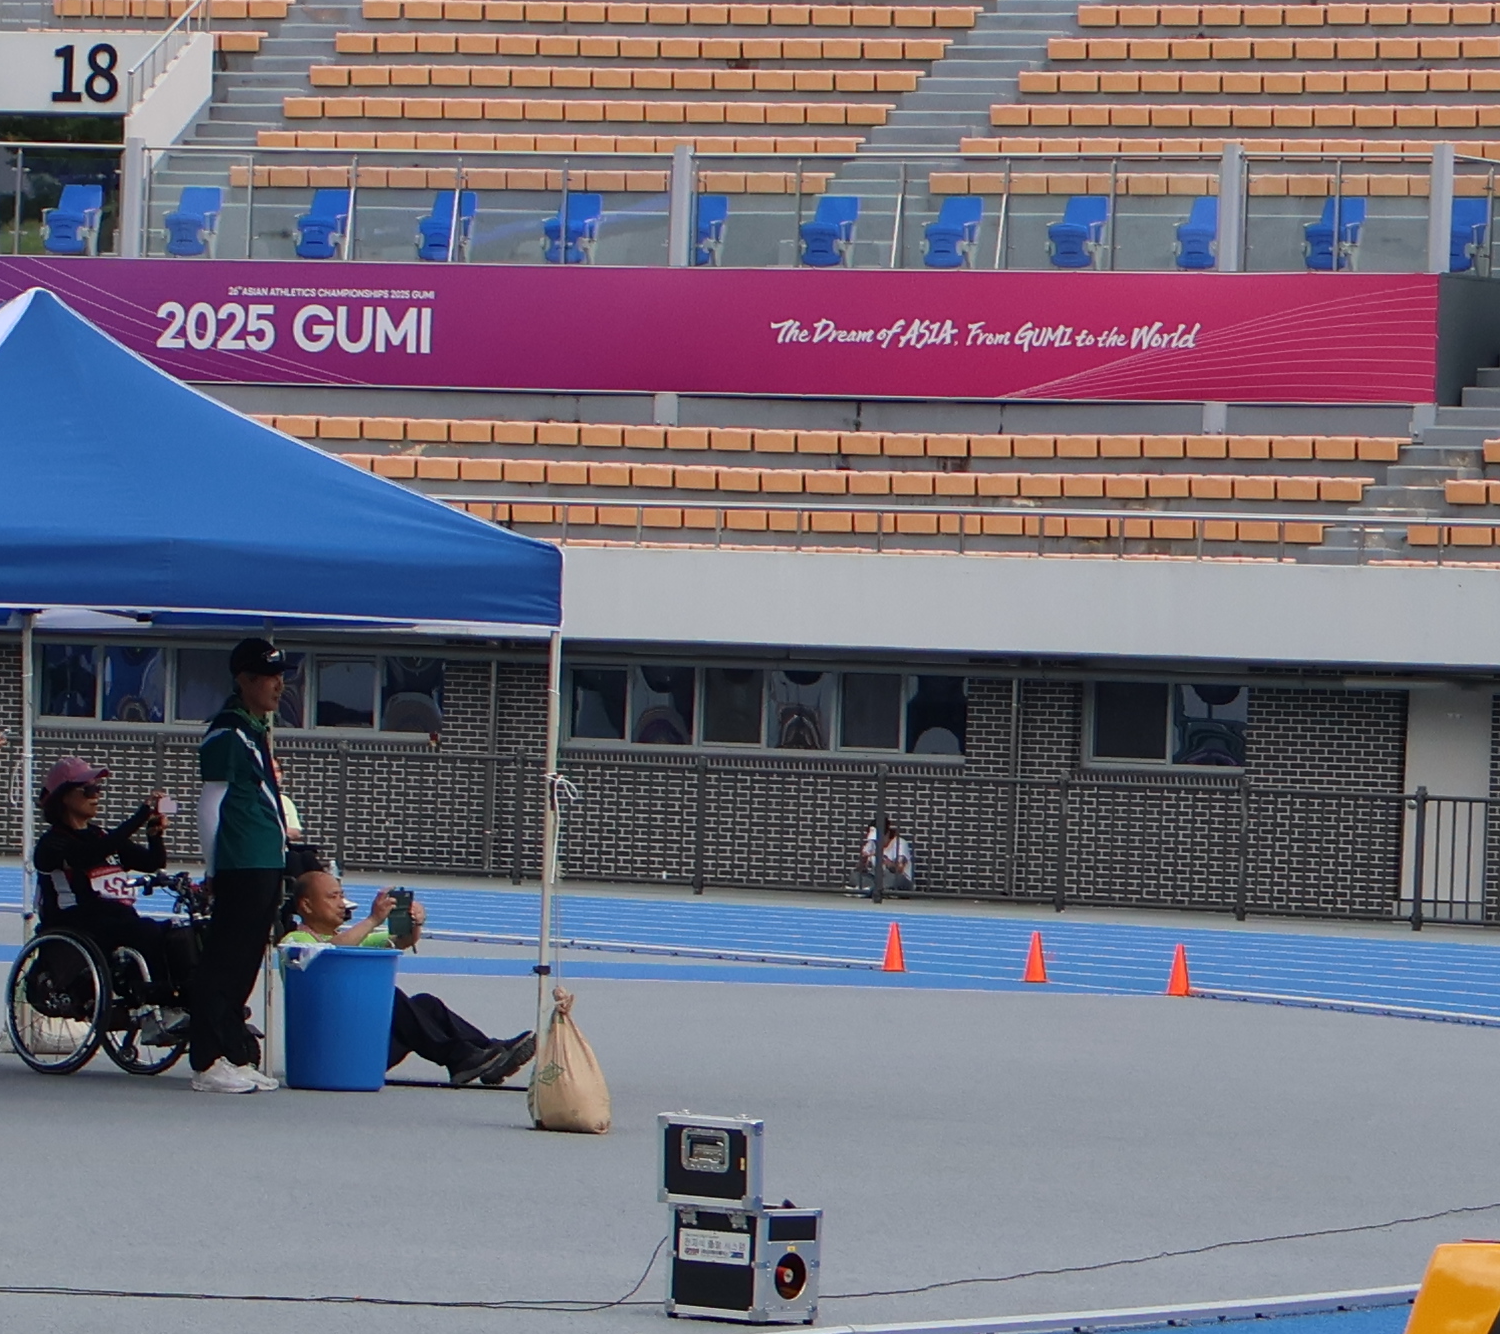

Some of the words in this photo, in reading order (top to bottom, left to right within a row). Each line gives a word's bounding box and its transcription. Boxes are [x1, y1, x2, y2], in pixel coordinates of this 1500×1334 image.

[51, 43, 118, 103] 18
[242, 287, 268, 296] ASIAN
[269, 288, 316, 297] ATHLETICS
[317, 288, 389, 298] CHAMPIONSHIPS
[411, 290, 435, 299] GUMI
[156, 301, 275, 351] 2025
[292, 304, 432, 354] GUMI
[770, 319, 811, 343] The
[812, 318, 874, 343] Dream
[876, 319, 905, 349] of
[966, 322, 1011, 346] From
[1014, 322, 1073, 352] GUMI
[1075, 329, 1095, 347] to
[1096, 327, 1129, 347] the
[1129, 322, 1201, 349] World
